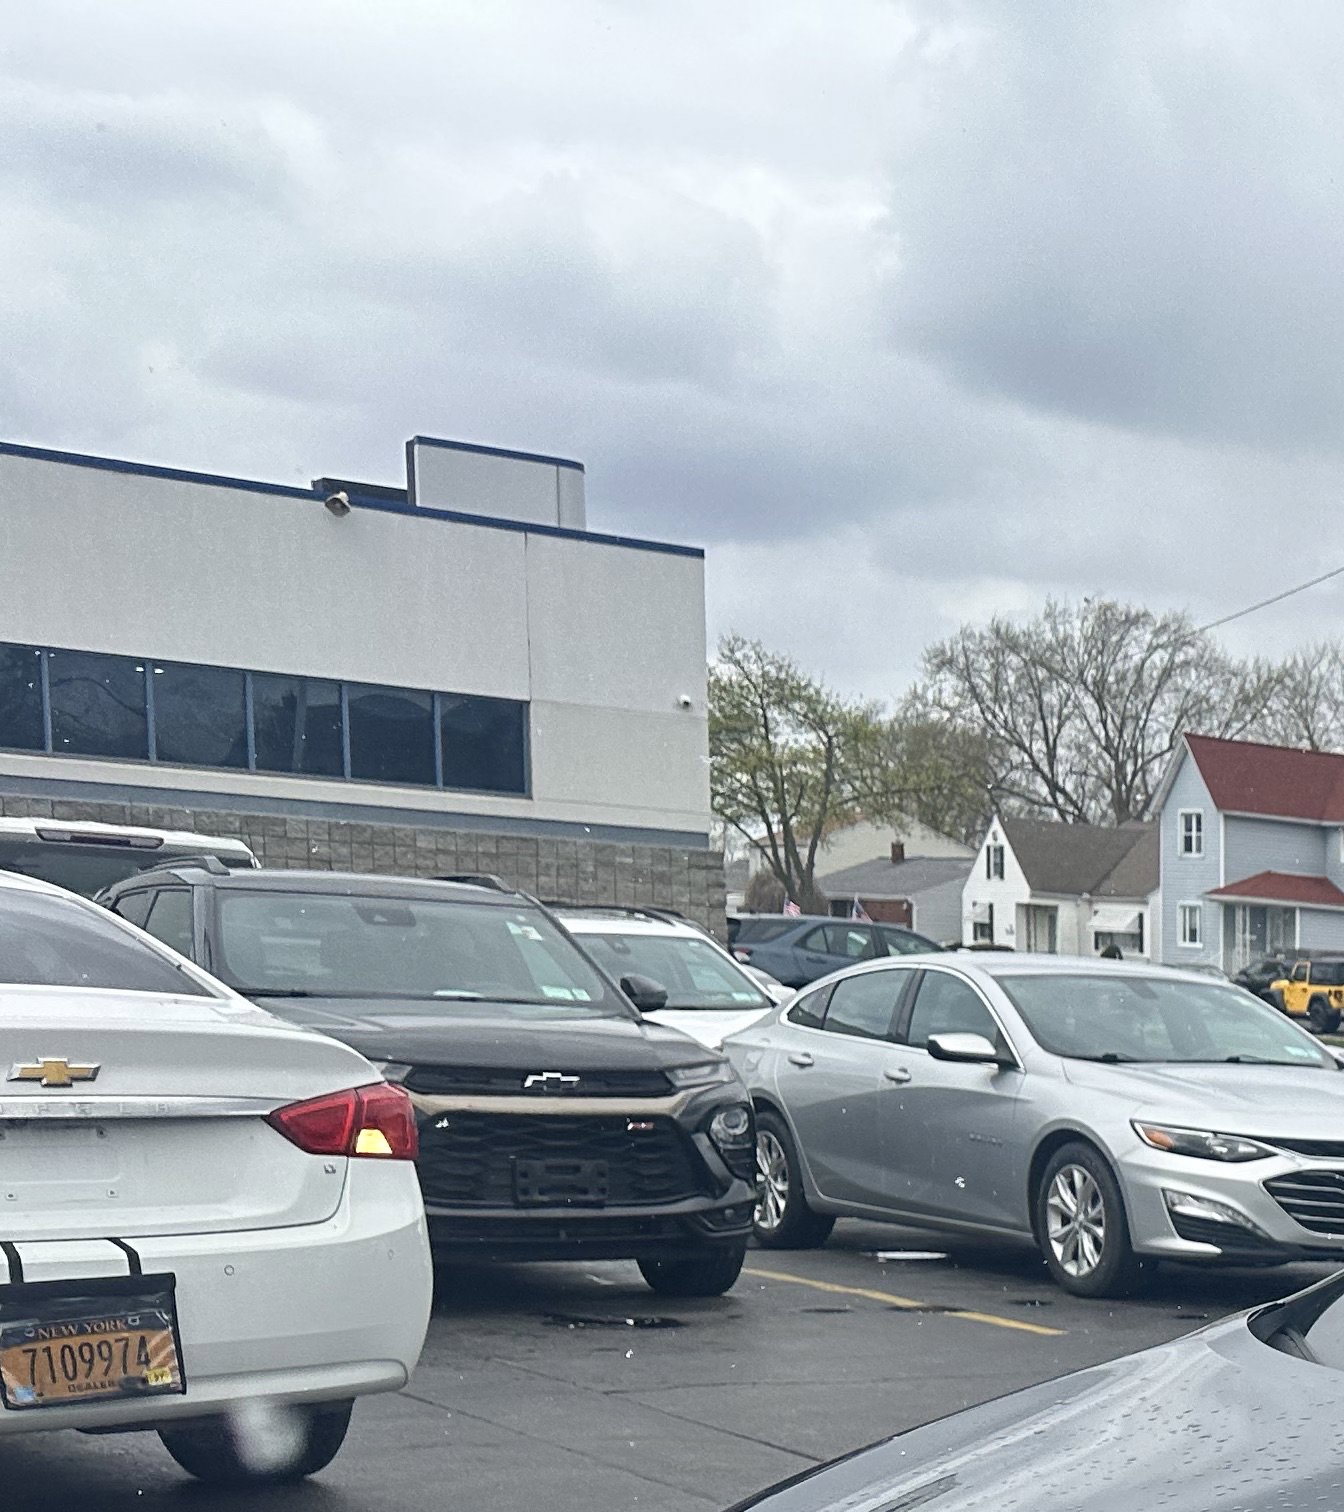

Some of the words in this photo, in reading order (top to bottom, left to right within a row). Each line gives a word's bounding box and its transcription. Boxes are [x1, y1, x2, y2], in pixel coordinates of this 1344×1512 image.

[37, 1323, 79, 1340] NEW
[84, 1318, 129, 1333] YORK
[22, 1335, 150, 1387] 7109974
[67, 1380, 116, 1393] DEALER
